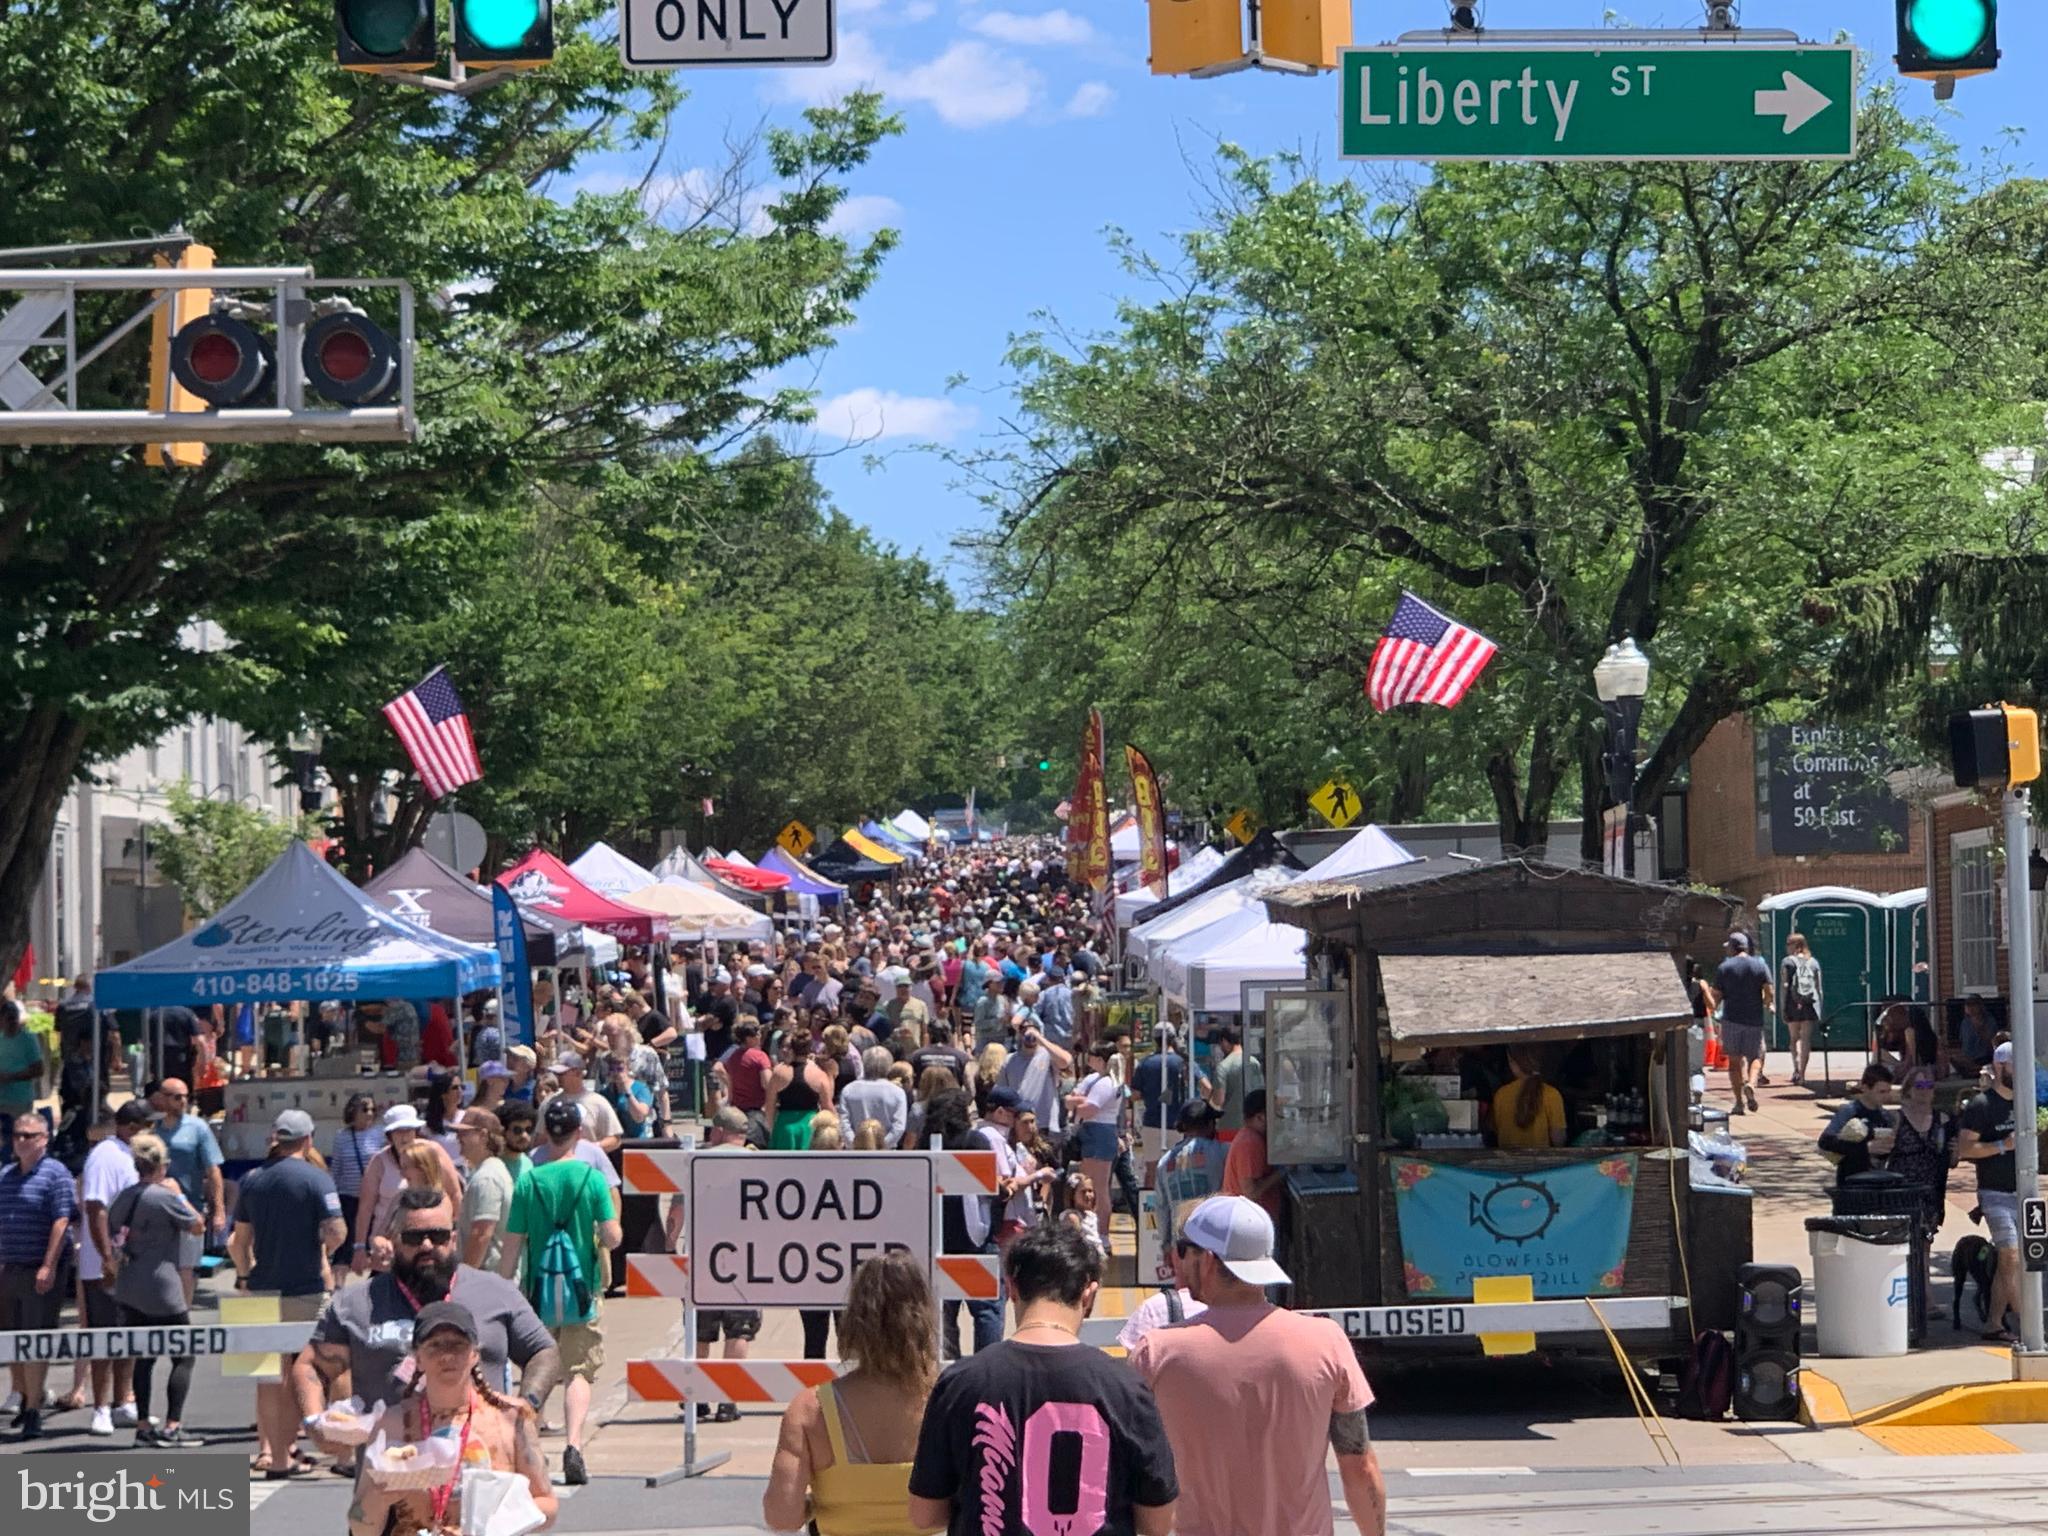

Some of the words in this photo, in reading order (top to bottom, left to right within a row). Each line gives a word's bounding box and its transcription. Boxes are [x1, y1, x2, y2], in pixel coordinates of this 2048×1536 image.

[656, 0, 799, 41] ONLY
[1360, 66, 1579, 142] Liberty
[1610, 65, 1657, 96] ST
[1793, 782, 1811, 800] at
[1794, 806, 1816, 827] 50
[223, 911, 380, 952] Sterling
[192, 972, 359, 996] 410-848-1025
[740, 1179, 883, 1220] ROAD
[1344, 1307, 1465, 1336] CLOSED
[15, 1332, 93, 1360] ROAD
[106, 1328, 227, 1355] CLOSED
